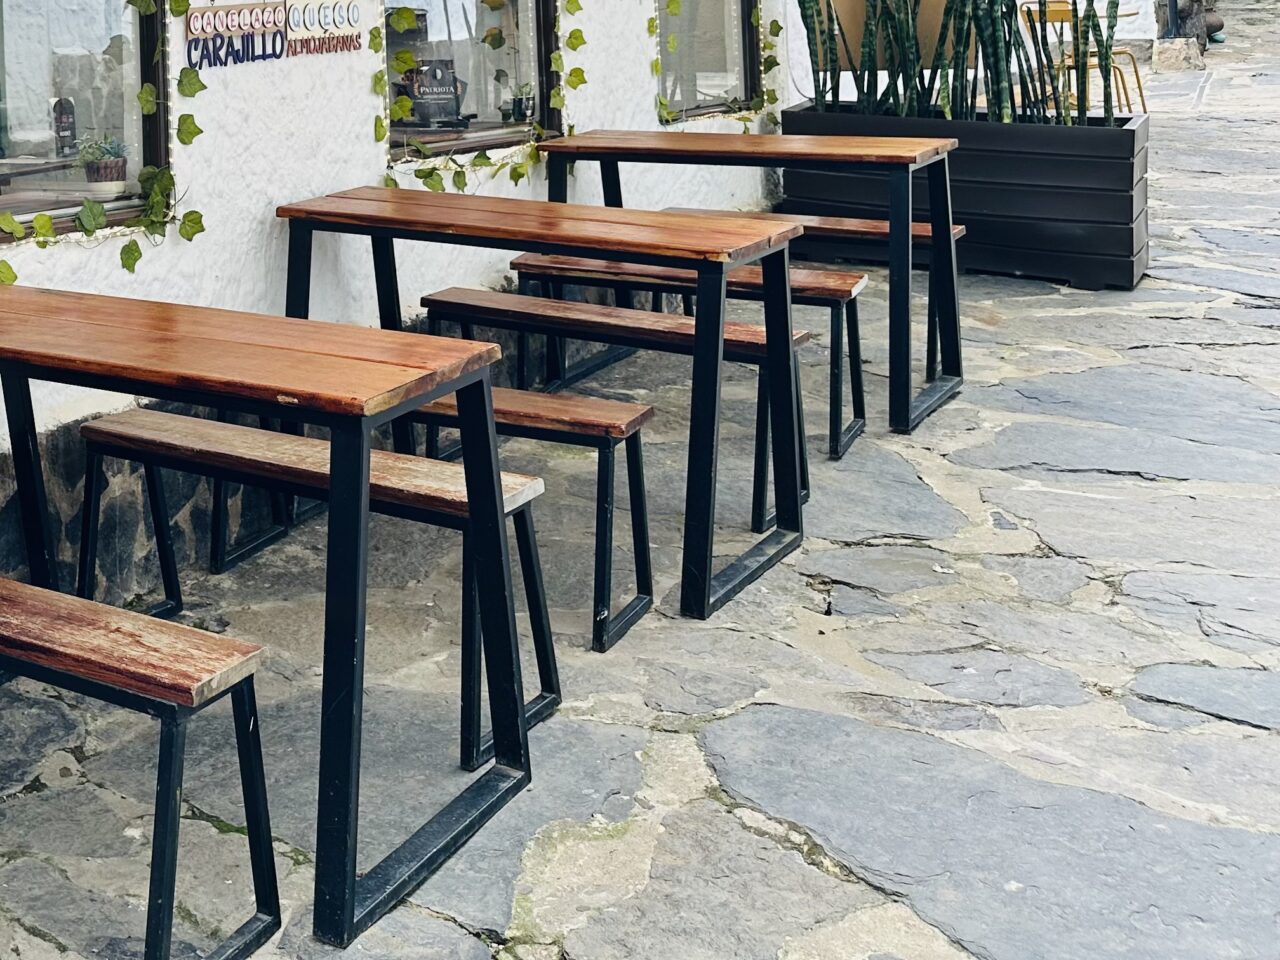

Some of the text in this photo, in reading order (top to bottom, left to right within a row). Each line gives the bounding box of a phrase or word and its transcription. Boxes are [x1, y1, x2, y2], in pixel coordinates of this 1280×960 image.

[191, 7, 285, 34] CANELAZO
[290, 0, 361, 31] QUESO
[186, 29, 285, 70] CARAJILLO
